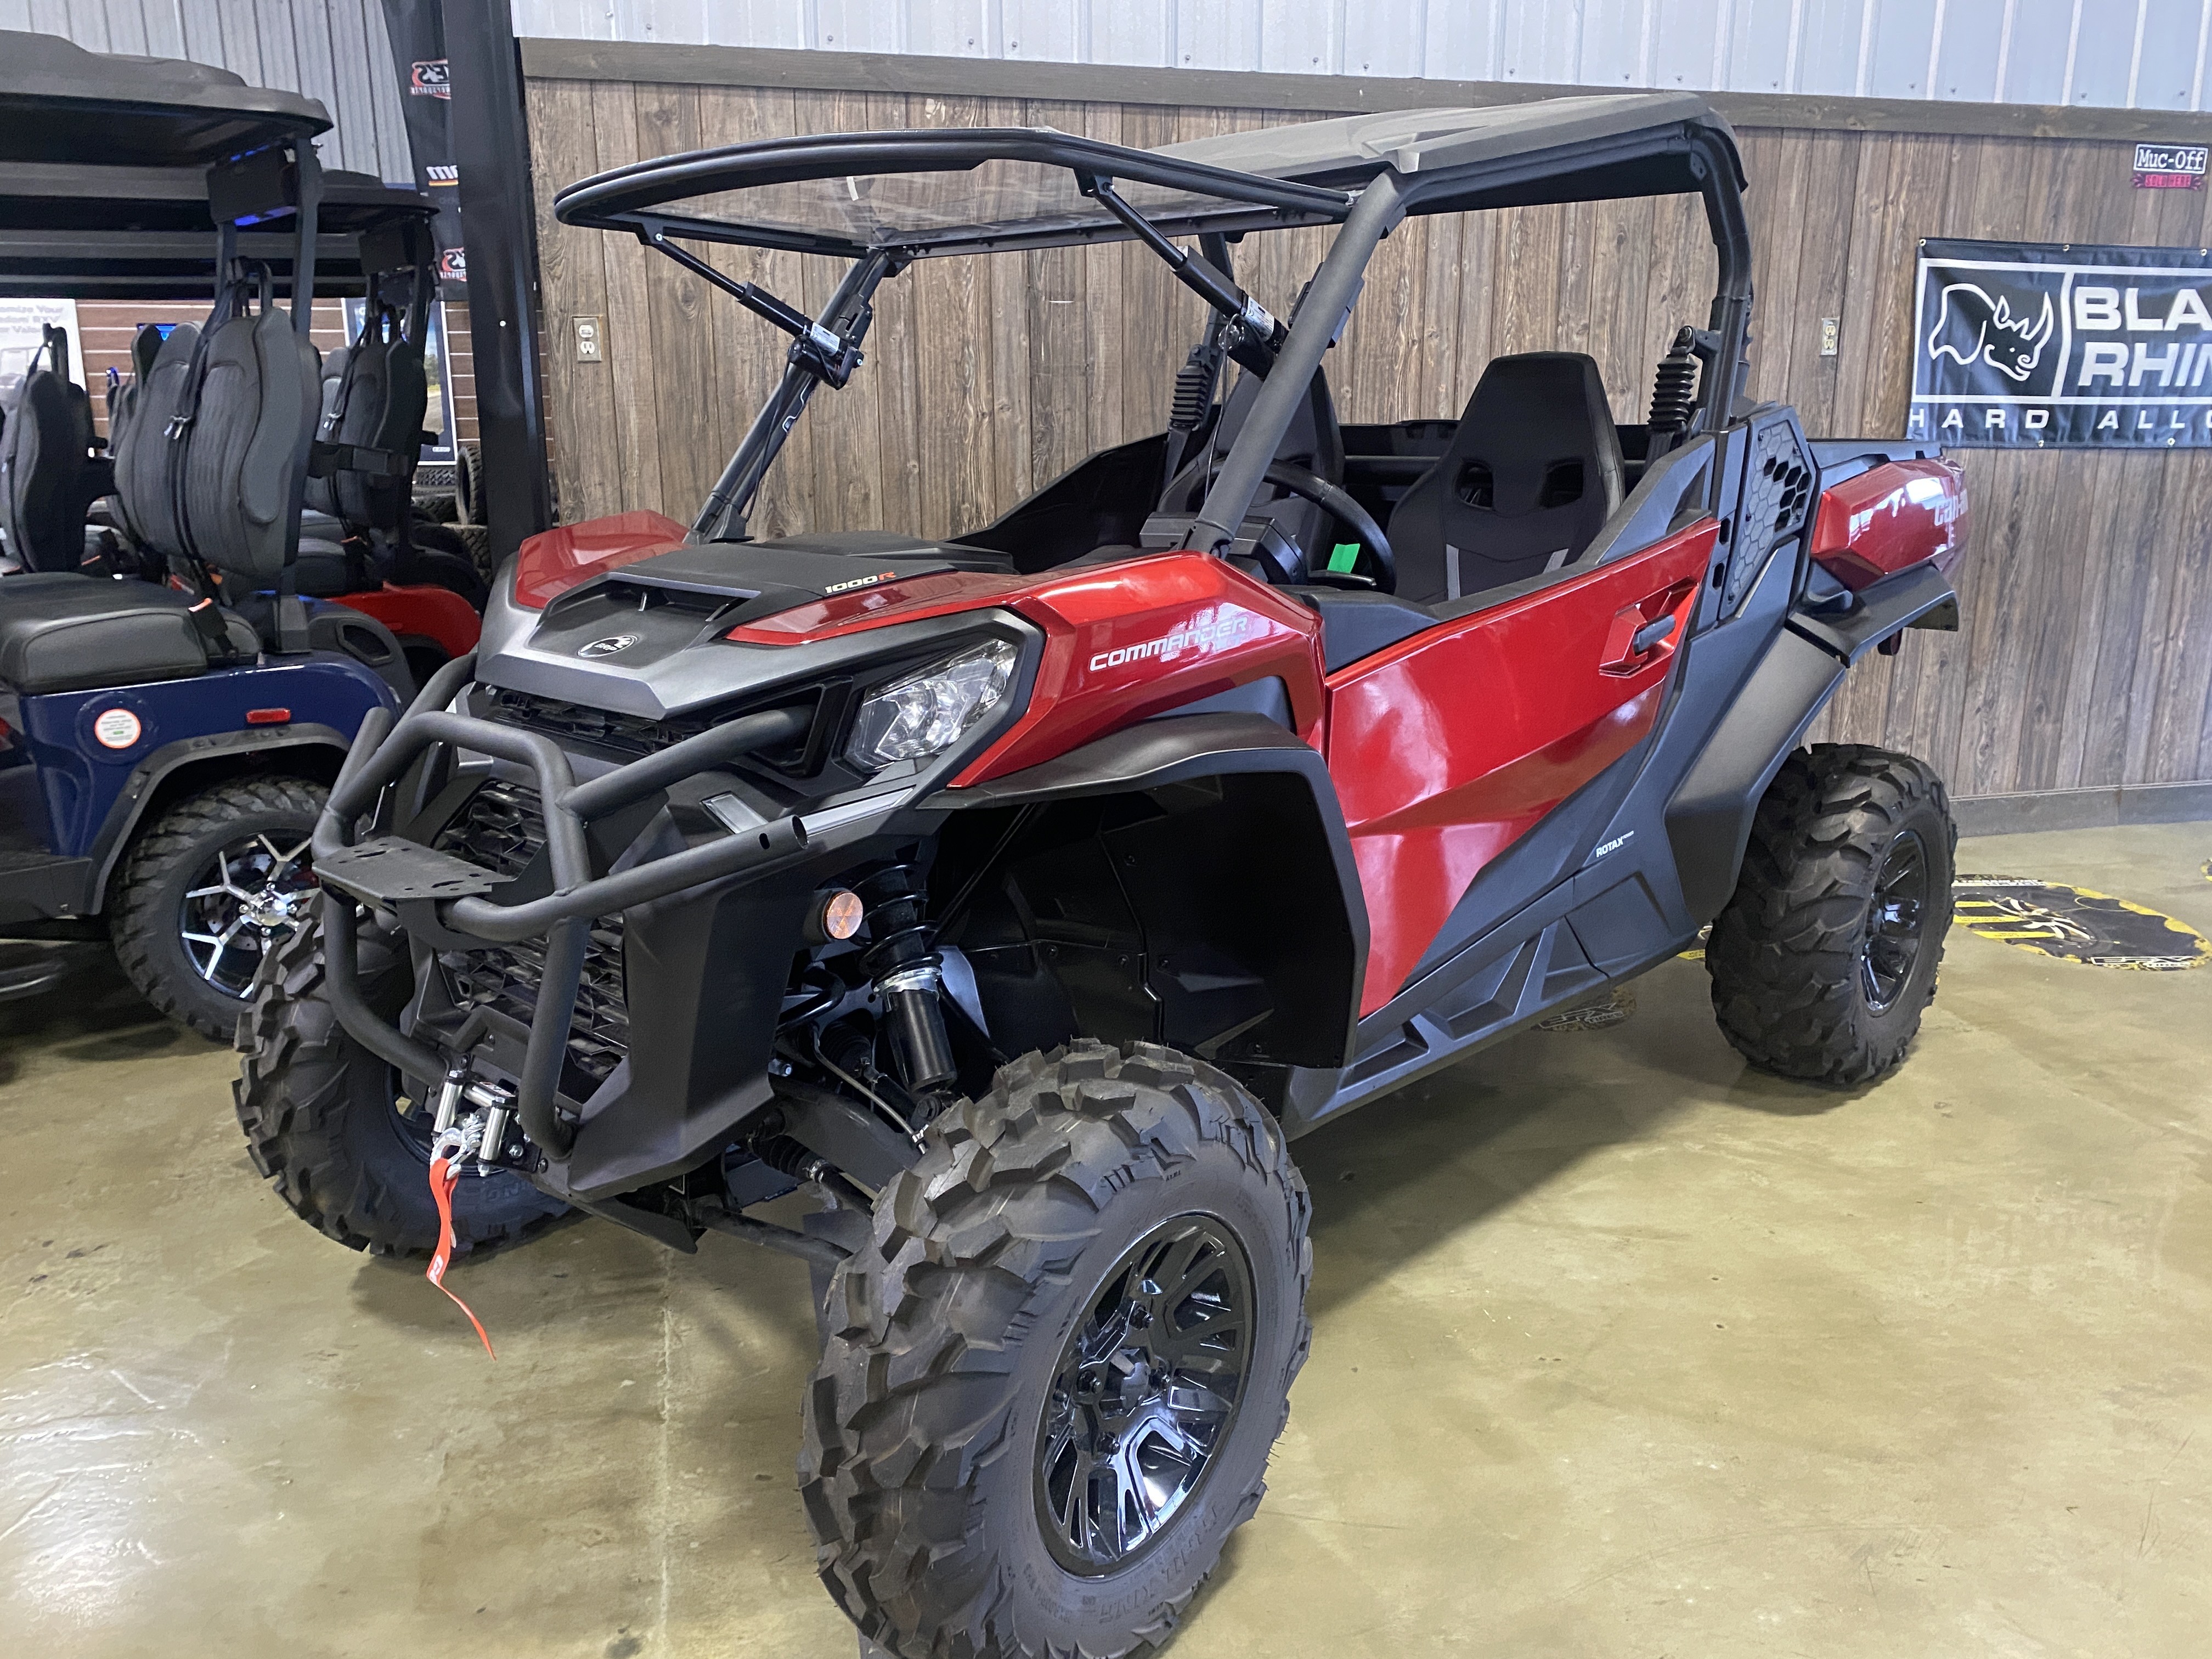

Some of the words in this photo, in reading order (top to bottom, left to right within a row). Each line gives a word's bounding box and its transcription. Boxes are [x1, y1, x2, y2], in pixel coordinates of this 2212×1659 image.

[2137, 149, 2205, 170] Muc-Off
[2074, 286, 2212, 331] BLA
[1909, 408, 2050, 429] HARD
[2097, 410, 2212, 430] ALL
[825, 571, 896, 594] 1000R
[594, 642, 619, 651] BRP
[1089, 616, 1249, 672] COMMANDER
[1596, 836, 1624, 858] ROTAX
